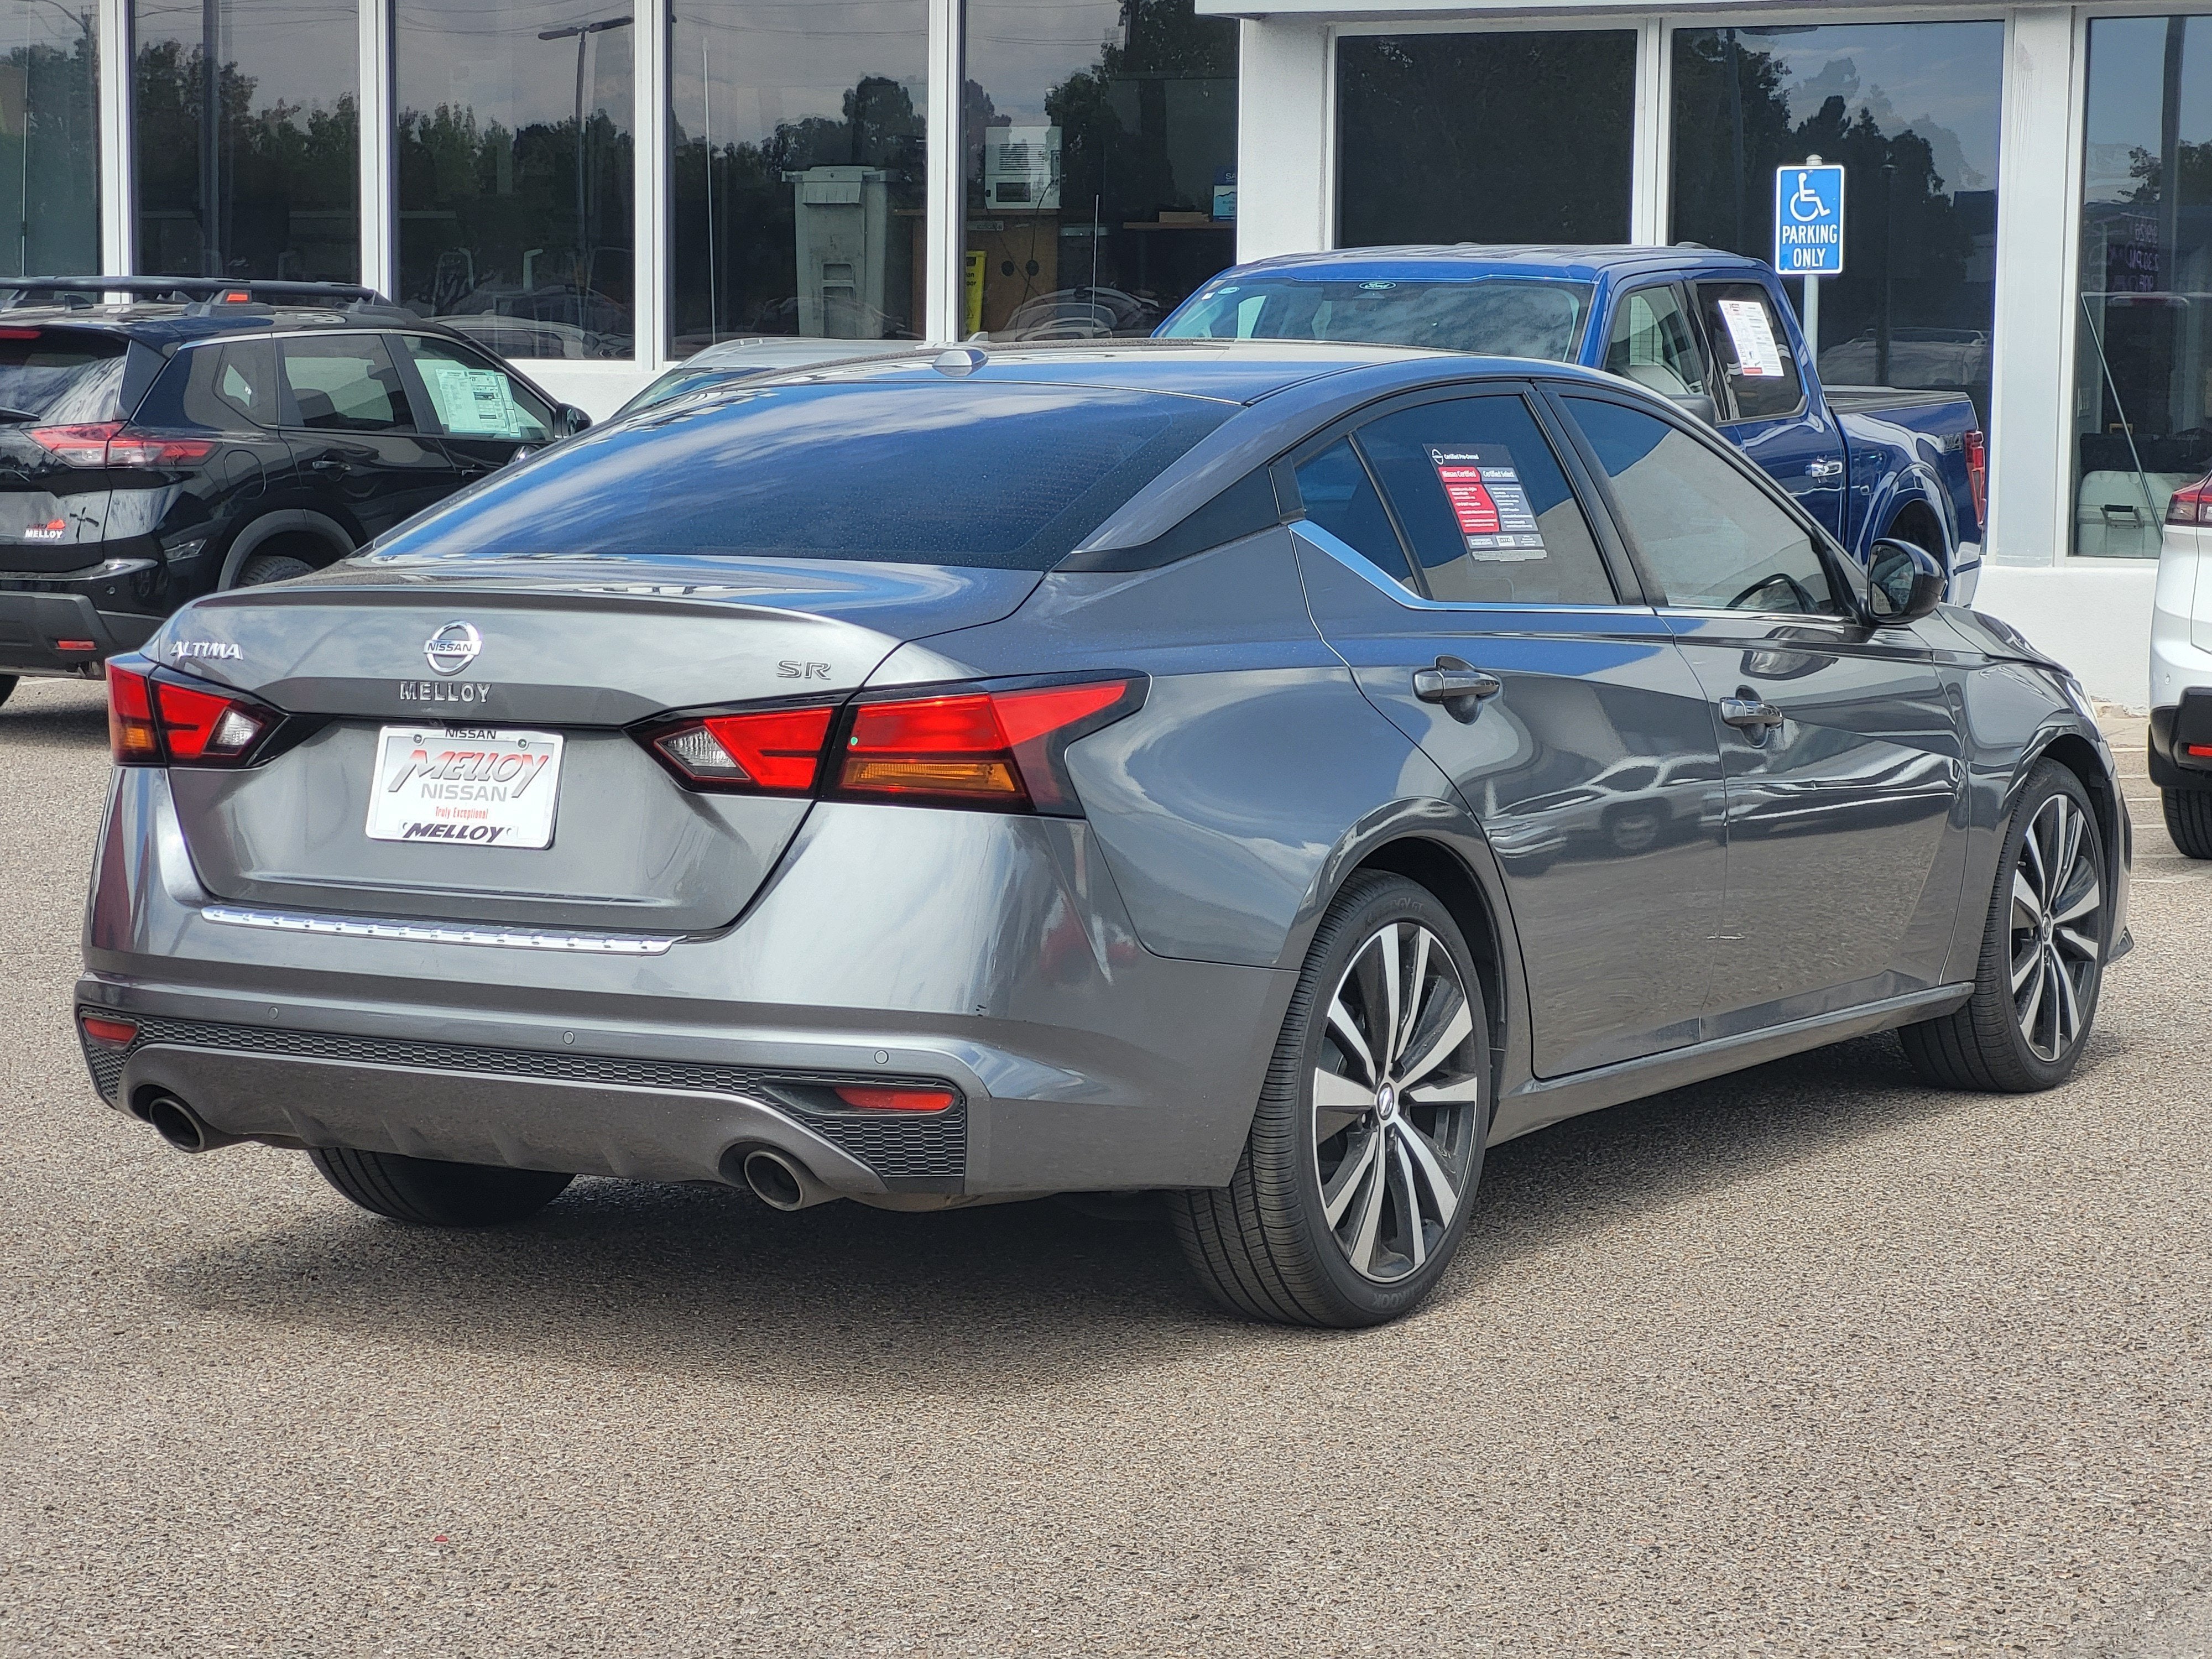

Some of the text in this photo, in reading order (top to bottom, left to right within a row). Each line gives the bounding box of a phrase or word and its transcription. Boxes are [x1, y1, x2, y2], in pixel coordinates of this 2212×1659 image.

[1782, 224, 1838, 244] PARKING
[1793, 248, 1827, 268] ONLY
[25, 529, 64, 539] MELLOY
[170, 640, 244, 661] ALTIMA
[427, 642, 473, 652] NISSAN
[776, 659, 831, 680] SR
[399, 681, 492, 703] MELLOY
[445, 729, 497, 740] NISSAN
[388, 749, 549, 798] MELLOY
[420, 783, 508, 802] NISSAN
[435, 806, 488, 820] Truly Exceptional
[402, 822, 505, 843] MELLOY
